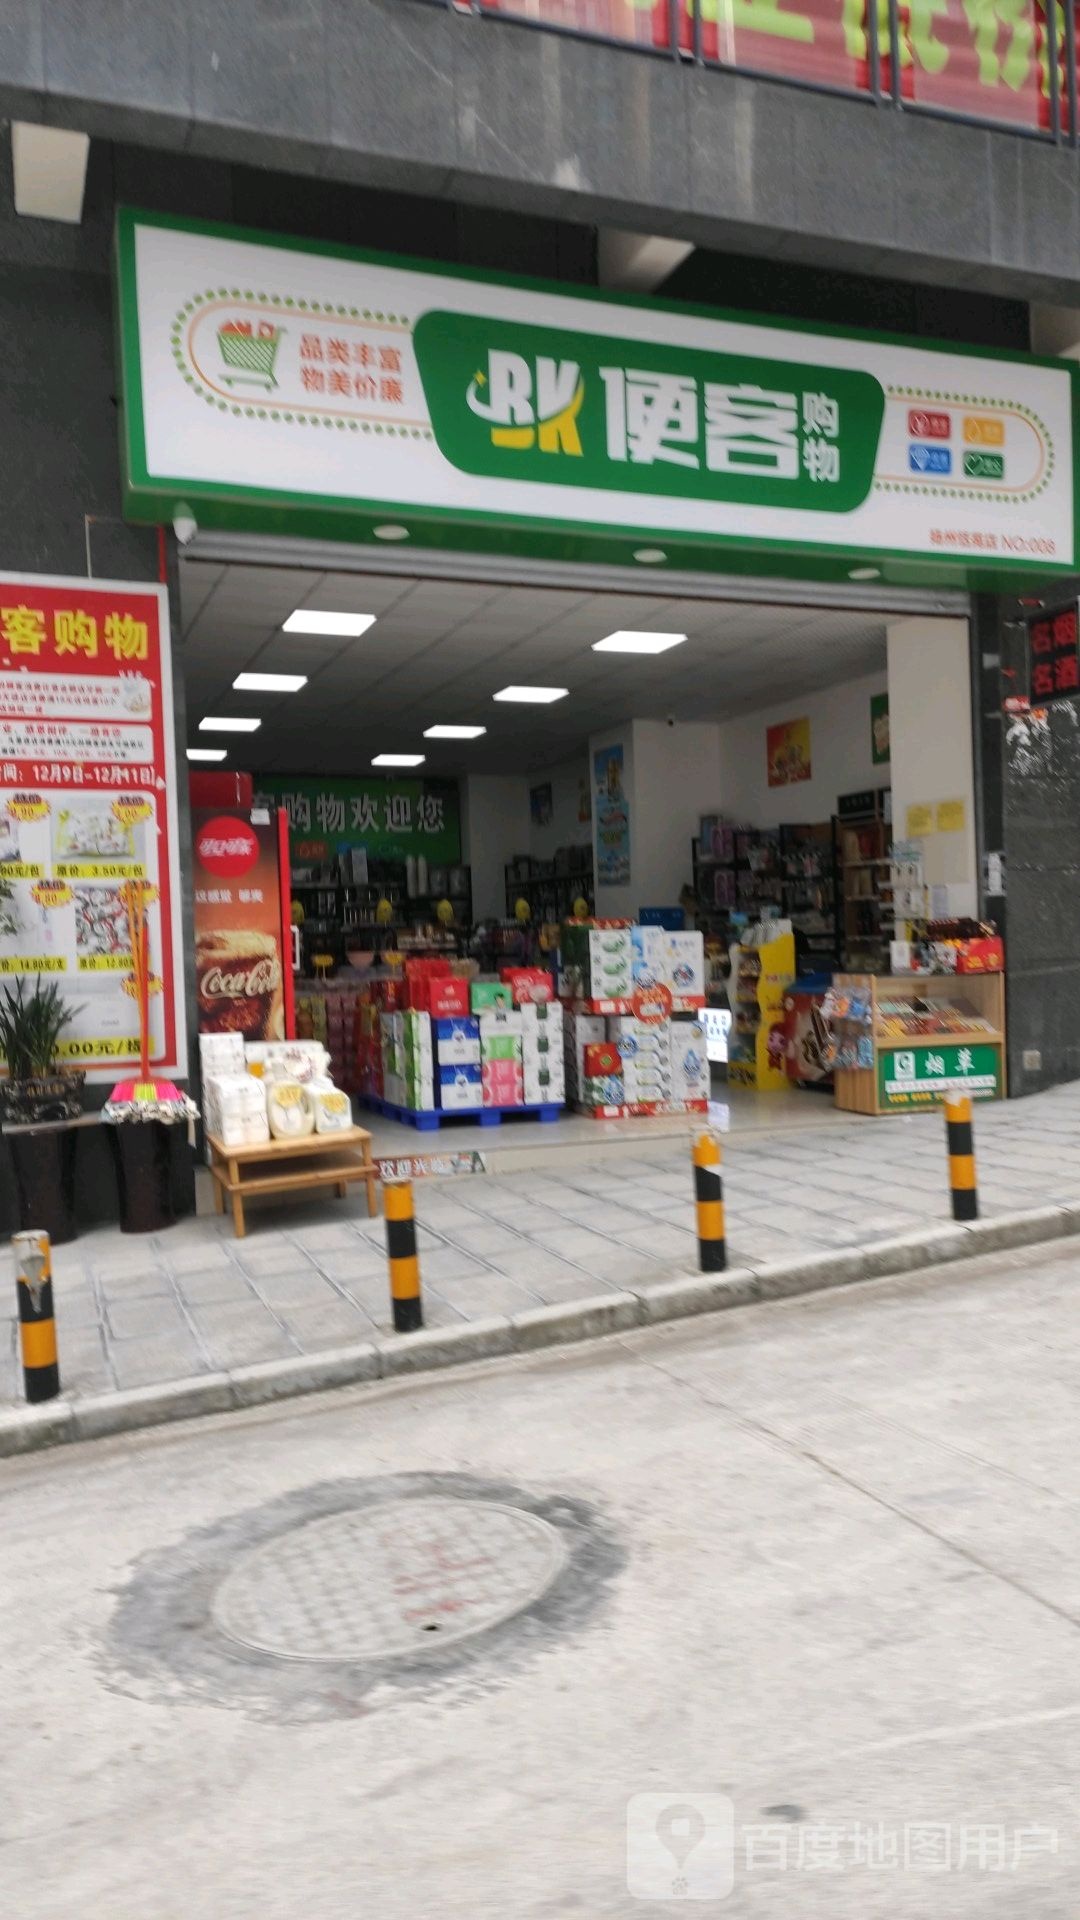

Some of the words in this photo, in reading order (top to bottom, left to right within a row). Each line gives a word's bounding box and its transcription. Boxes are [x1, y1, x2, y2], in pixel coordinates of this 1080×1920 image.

[299, 333, 403, 374] 品类丰富
[300, 365, 405, 405] 物美价廉
[598, 366, 800, 480] 便客
[801, 391, 841, 483] 购物
